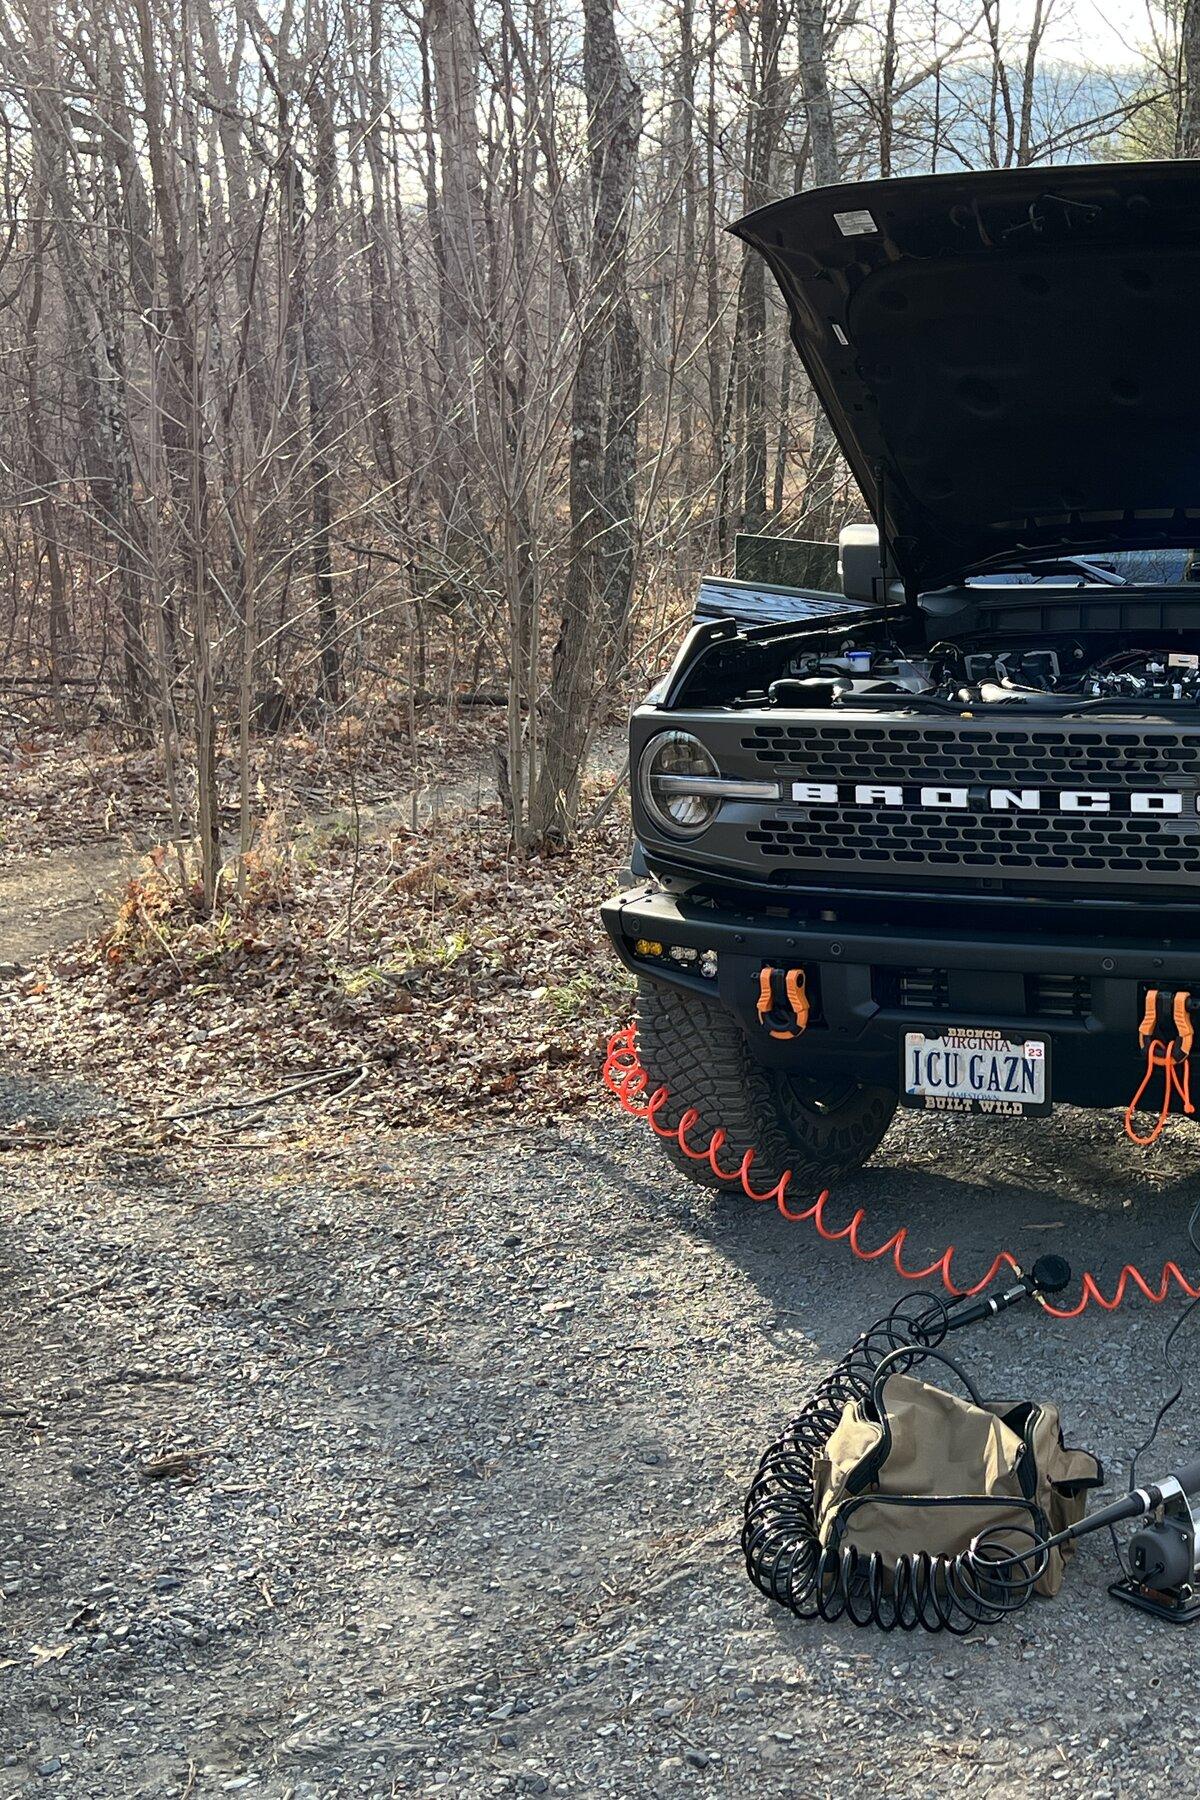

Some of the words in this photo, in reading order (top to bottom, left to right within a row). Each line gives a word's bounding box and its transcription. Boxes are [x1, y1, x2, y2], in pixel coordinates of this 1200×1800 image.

[791, 781, 1183, 814] BRONCO
[947, 1028, 1002, 1040] BRONCO
[941, 1036, 1012, 1053] VIRGINIA
[1028, 1048, 1043, 1057] 23
[913, 1050, 959, 1088] ICU
[969, 1054, 1037, 1095] GAZN
[924, 1096, 973, 1112] BUILT
[978, 1100, 1023, 1116] WILD
